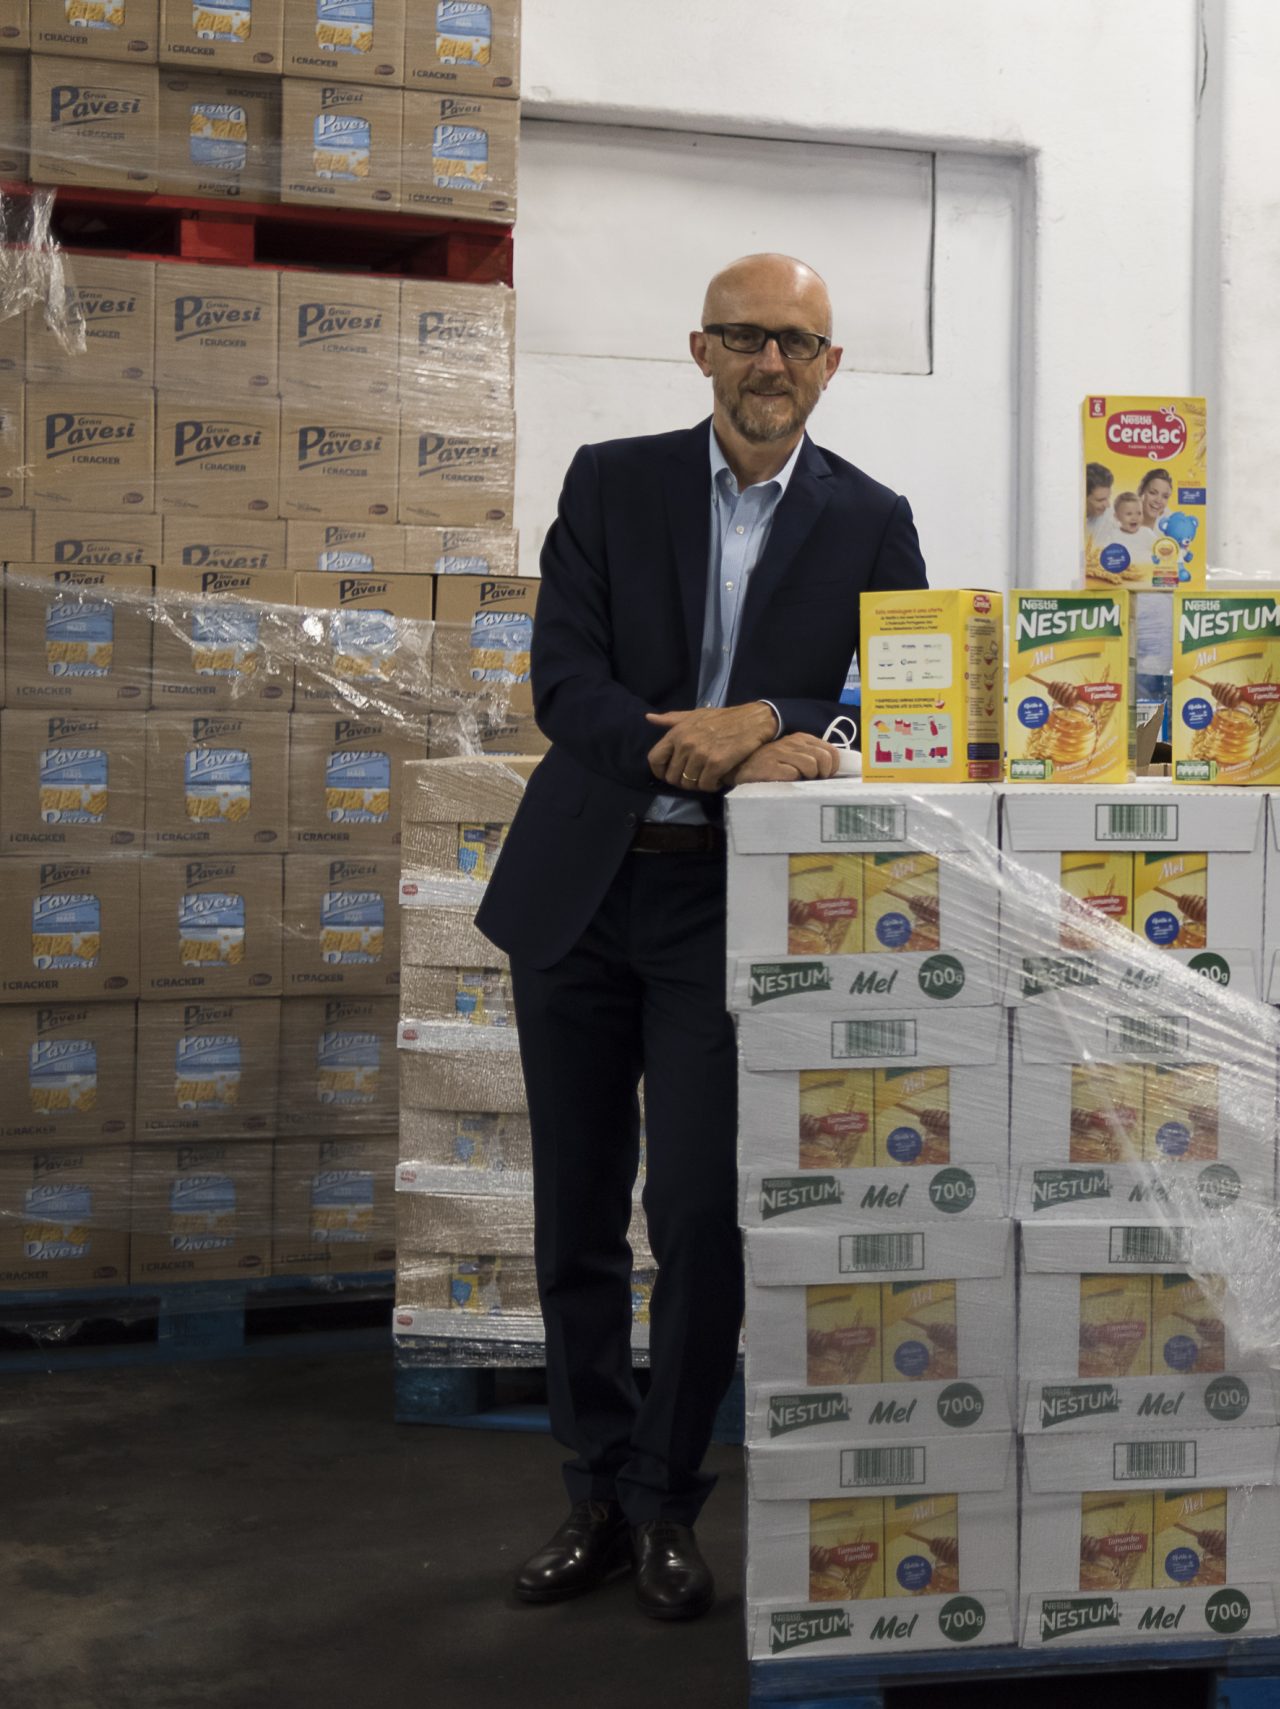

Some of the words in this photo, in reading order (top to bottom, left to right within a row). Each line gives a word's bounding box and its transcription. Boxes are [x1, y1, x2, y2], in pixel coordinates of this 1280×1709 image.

[44, 34, 88, 44] CRACKER
[173, 45, 215, 56] CRACKER
[297, 57, 338, 67] CRACKER
[417, 70, 457, 80] CRACKER
[51, 86, 140, 121] Pavesi
[64, 287, 136, 317] avesi
[175, 297, 261, 331] Pavesi
[299, 304, 381, 337] Pavesi
[1095, 404, 1100, 413] 6
[1121, 415, 1152, 424] Nestlé
[46, 414, 135, 448] Pavesi
[175, 421, 261, 456] Pavesi
[1109, 425, 1180, 444] Cerelac
[299, 427, 382, 461] Pavesi
[419, 434, 498, 466] Pavesi
[78, 456, 120, 465] CRACKER
[202, 573, 250, 592] Pavesi
[340, 580, 387, 599] Pavesi
[480, 582, 526, 601] Pavesi
[1022, 599, 1058, 610] Nestlé
[1185, 600, 1220, 611] Nestlé
[1015, 606, 1120, 640] NESTUM
[1179, 605, 1280, 640] NESTUM
[1031, 652, 1055, 666] Mel
[1194, 653, 1217, 669] Mel
[23, 687, 72, 696] CRACKER
[1083, 684, 1115, 693] Tamanho
[1091, 692, 1118, 700] Familiar
[1247, 685, 1276, 693] Tamanho
[15, 833, 65, 842] CRACKER
[304, 832, 349, 842] CRACKER
[1158, 858, 1185, 881] Mel
[9, 980, 58, 990] CRACKER
[156, 978, 204, 987] CRACKER
[751, 967, 829, 996] NESTUM
[850, 970, 898, 994] Mel
[921, 967, 963, 989] 700g
[760, 1181, 841, 1211] NESTUM
[861, 1184, 909, 1208] Mel
[932, 1181, 974, 1202] 700g
[1033, 1178, 1109, 1200] NESTUM
[768, 1399, 848, 1428] NESTUM
[869, 1399, 917, 1424] Mel
[940, 1397, 982, 1417] 700g
[1041, 1390, 1118, 1418] NESTUM
[1137, 1391, 1184, 1416] Mel
[1207, 1389, 1248, 1408] 700g
[1178, 1495, 1203, 1516] Mel
[1041, 1603, 1118, 1631] NESTUM
[1138, 1604, 1185, 1630] Mel
[1208, 1602, 1248, 1622] 700g
[770, 1614, 849, 1645] NESTUM
[870, 1614, 919, 1640] Mel
[941, 1610, 983, 1631] 700g
